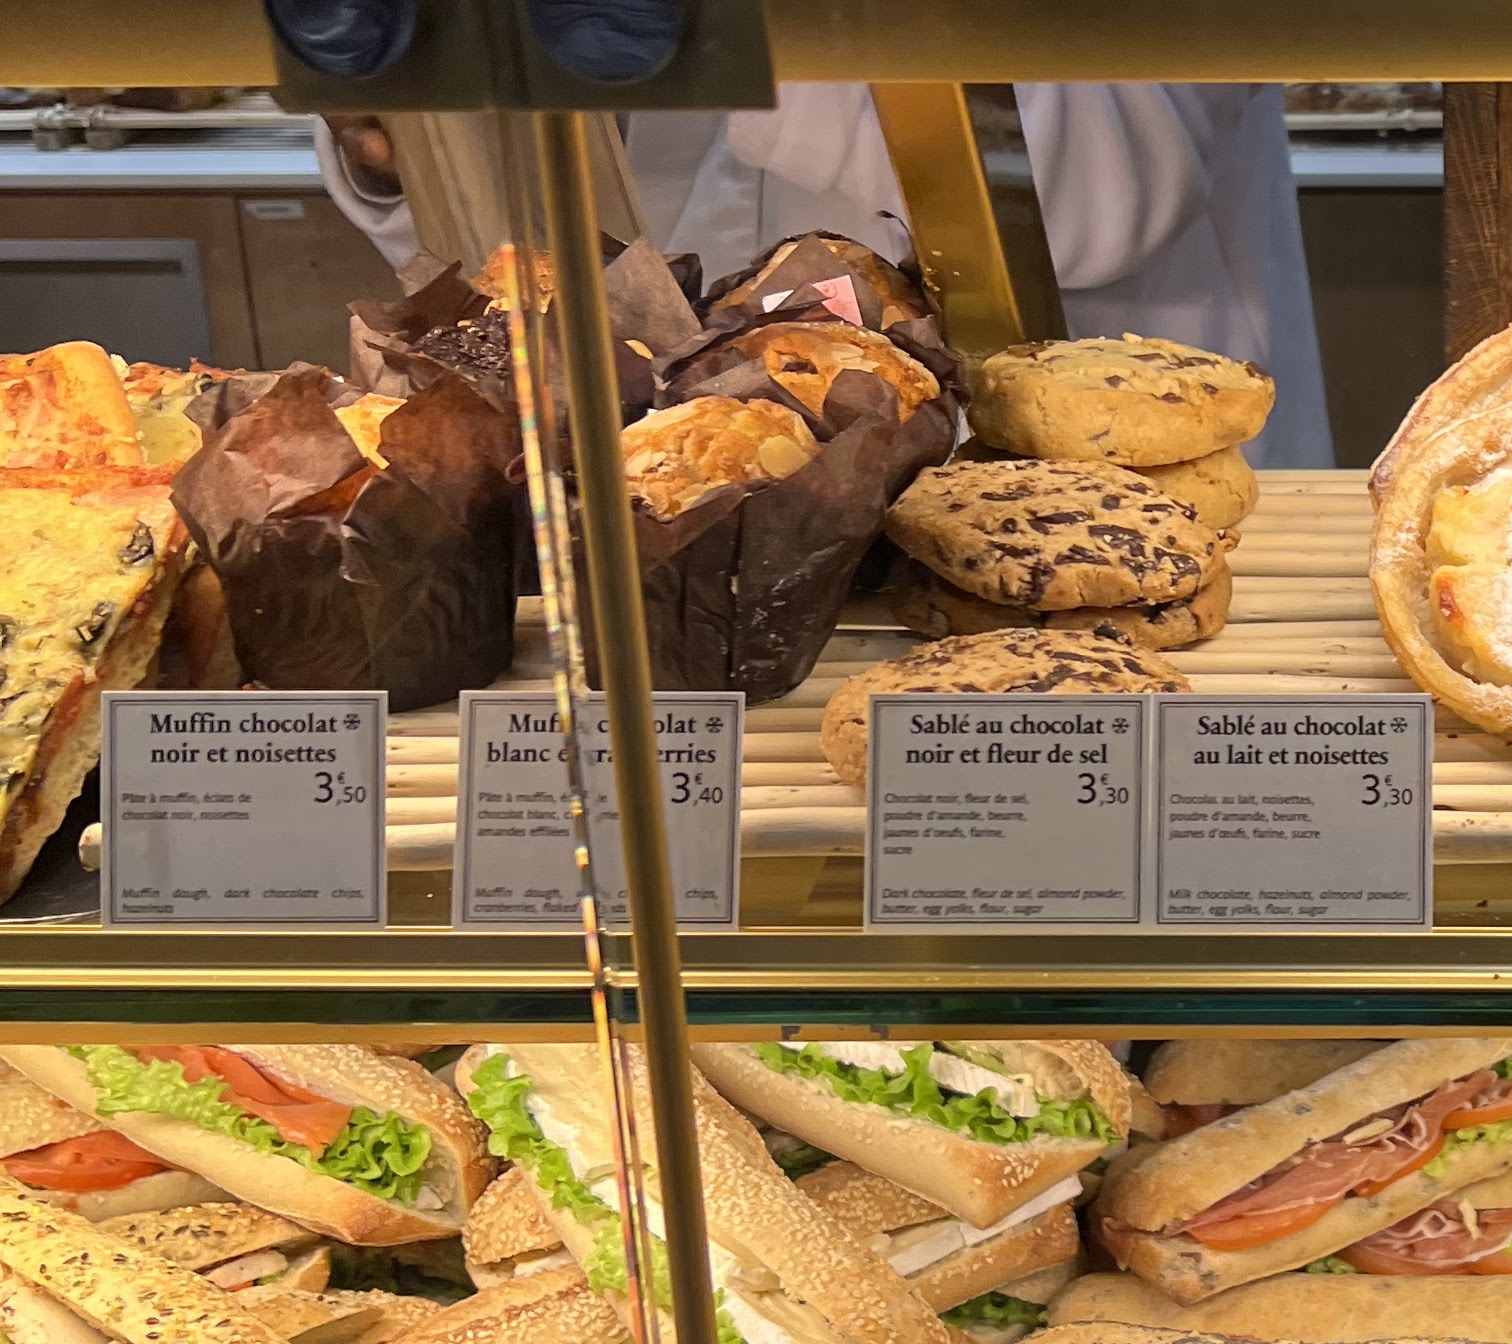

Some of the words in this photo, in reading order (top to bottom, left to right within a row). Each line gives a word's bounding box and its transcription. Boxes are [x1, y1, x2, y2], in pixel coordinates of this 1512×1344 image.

[150, 712, 232, 733] Muffin
[239, 712, 337, 733] chocolat
[509, 713, 567, 733] Muf
[598, 713, 696, 733] colat
[910, 714, 970, 734] Sablé
[976, 721, 1003, 734] au
[1010, 714, 1104, 734] chocolat
[1197, 715, 1255, 735] Sablé
[1261, 722, 1287, 735] au
[1294, 715, 1386, 735] chocolat
[151, 743, 200, 763] noir
[207, 747, 228, 762] et
[236, 742, 336, 762] noisettes
[487, 742, 550, 762] blanc
[906, 743, 955, 763] noir
[960, 748, 981, 763] et
[987, 743, 1041, 763] fleur
[1047, 743, 1073, 763] de
[1079, 744, 1107, 763] sel
[1194, 751, 1220, 764] au
[1227, 744, 1263, 764] lait
[1269, 748, 1289, 764] et
[1294, 745, 1388, 764] noisettes
